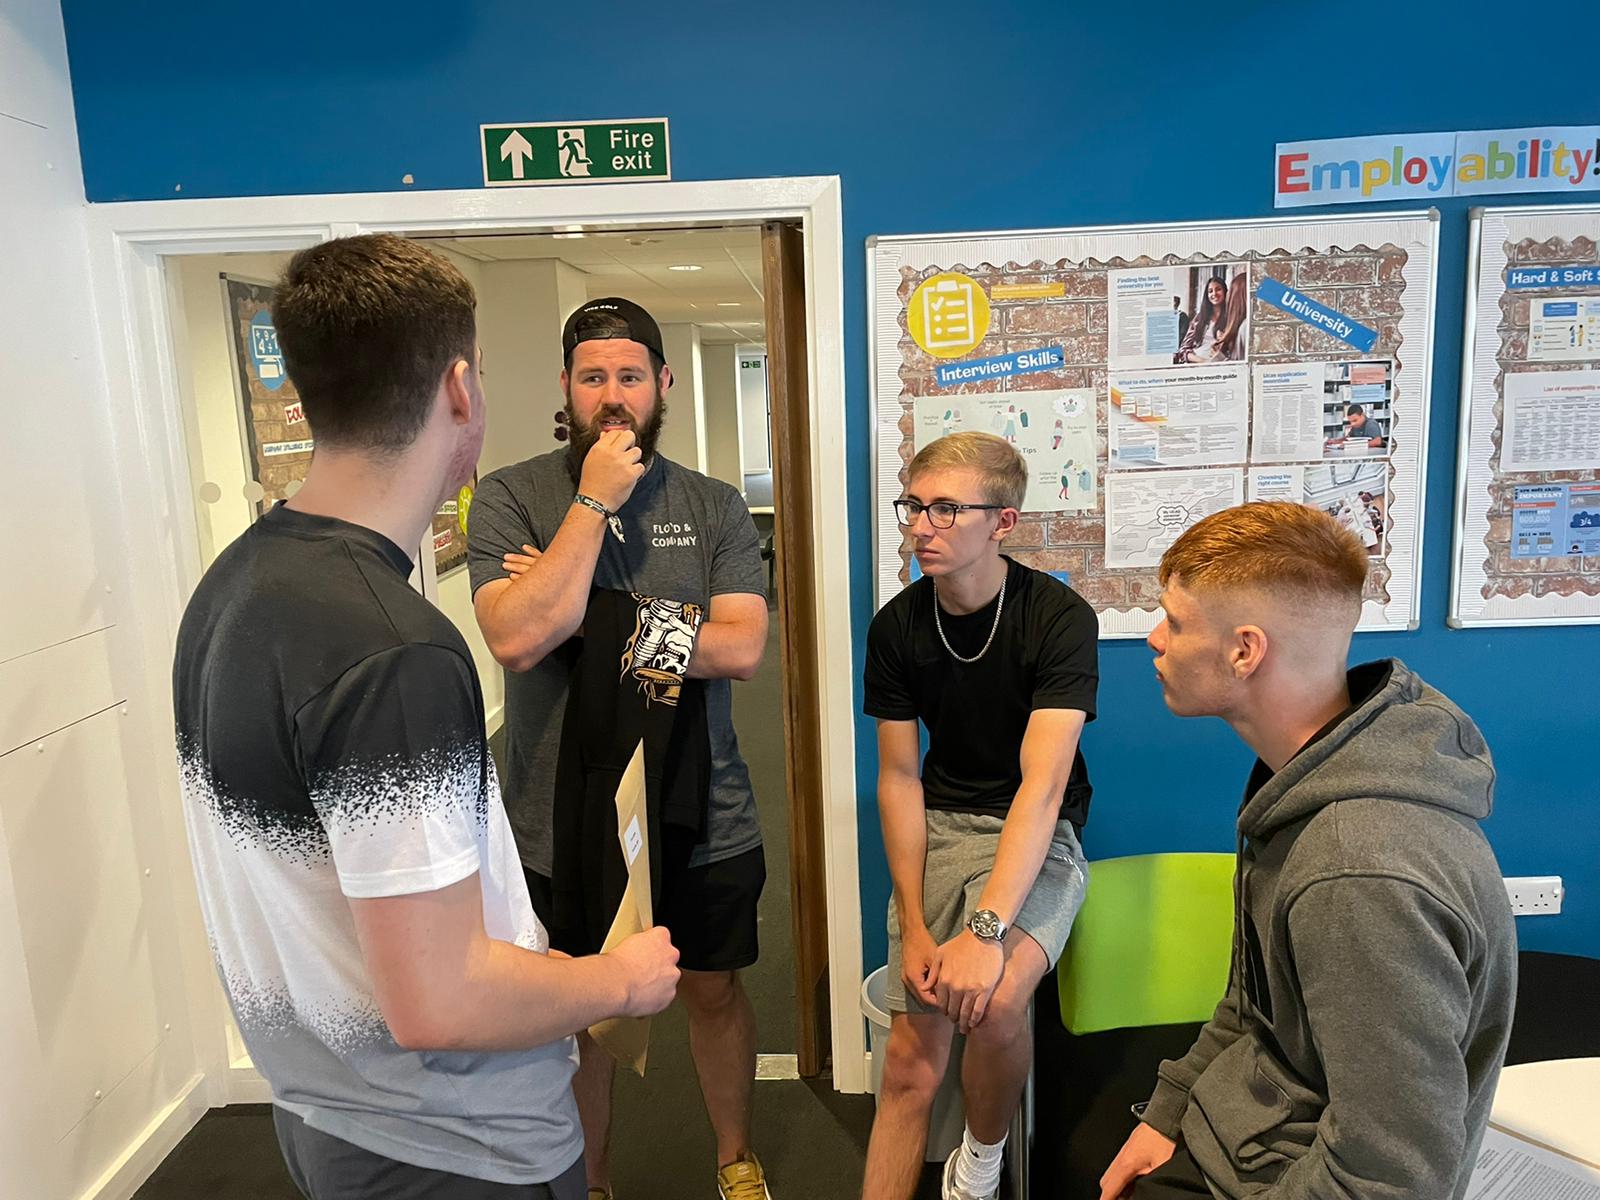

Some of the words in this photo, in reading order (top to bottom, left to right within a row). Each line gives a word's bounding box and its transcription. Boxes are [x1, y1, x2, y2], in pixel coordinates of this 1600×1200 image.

[609, 129, 655, 149] Fire
[611, 150, 653, 171] exit
[1511, 271, 1547, 285] Hard
[1550, 270, 1560, 283] &
[1563, 269, 1594, 282] Soft
[1280, 291, 1354, 339] University
[941, 359, 1013, 382] Interview
[1016, 351, 1059, 370] Skills
[1177, 373, 1222, 383] month-by-month
[1222, 373, 1238, 381] guide
[1519, 491, 1564, 499] IMPORTANT
[683, 523, 692, 532] &
[1579, 517, 1593, 527] 3/4
